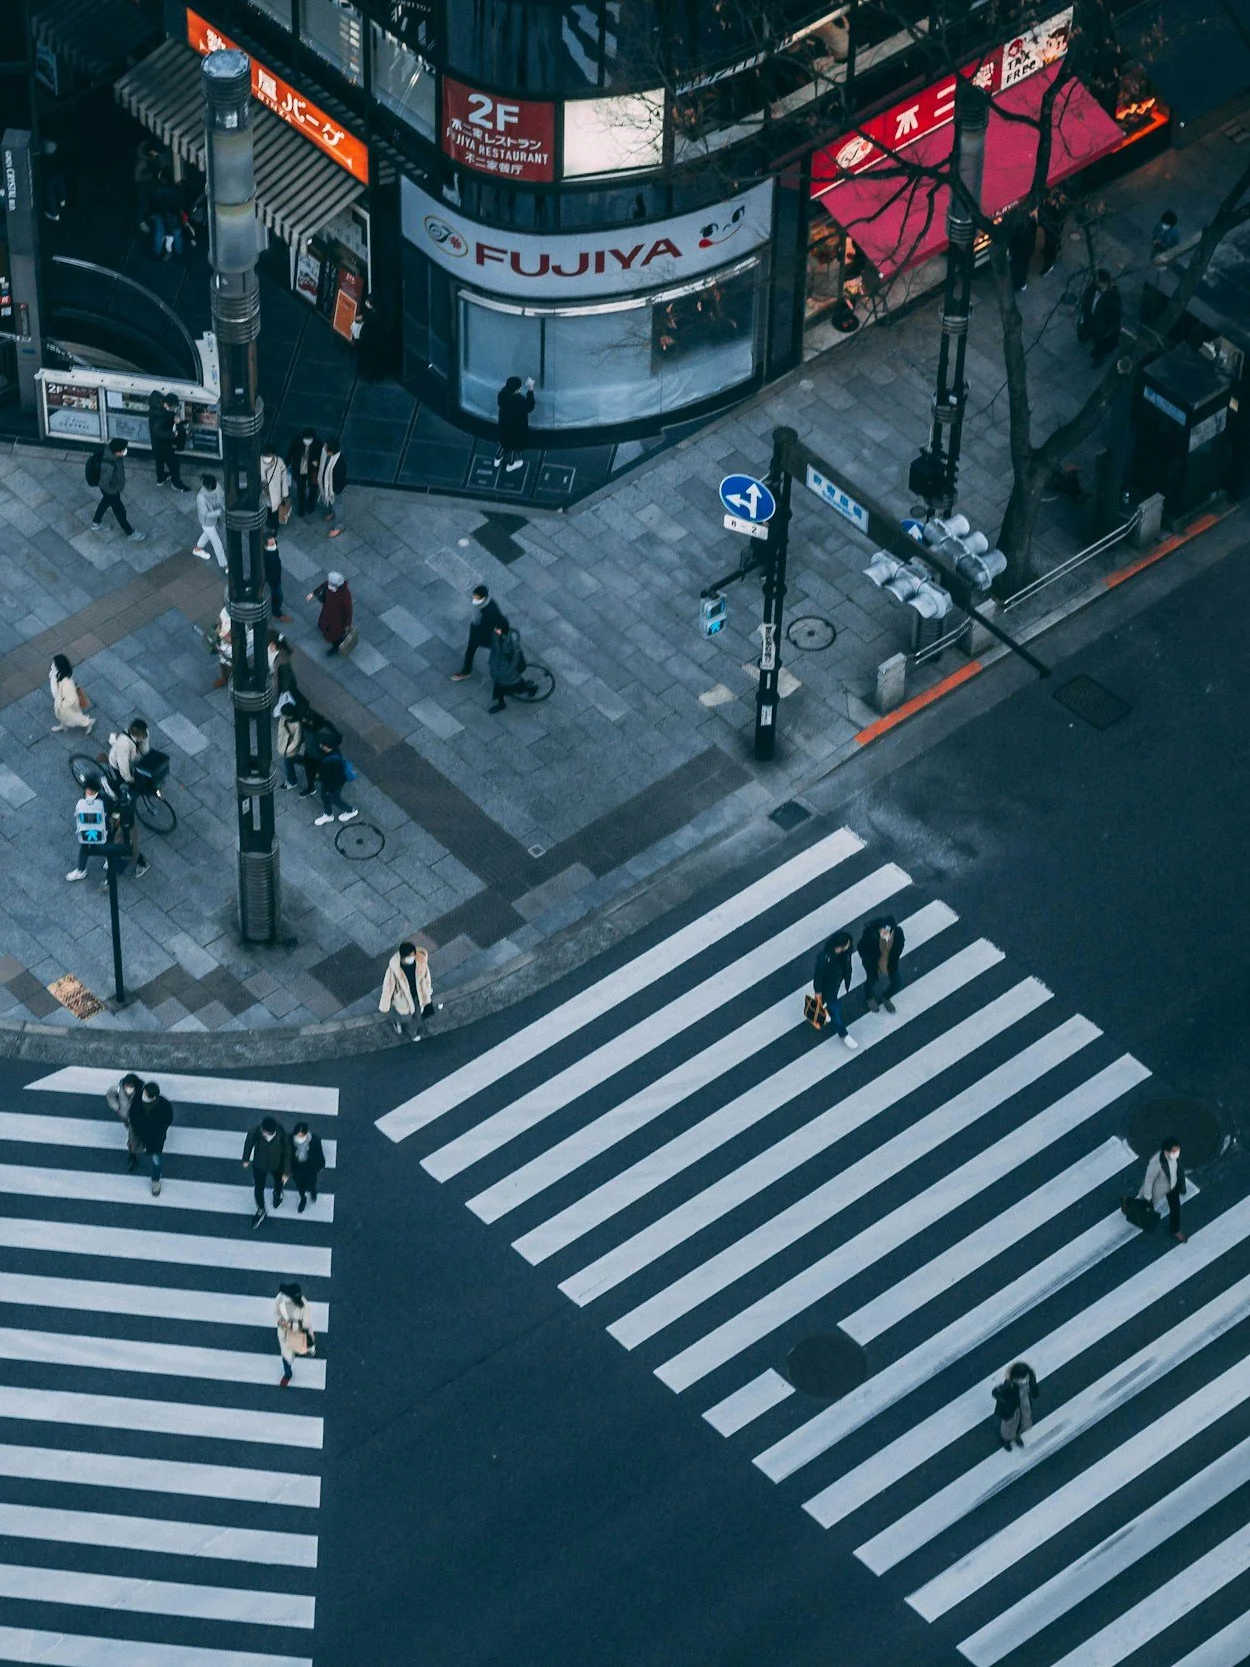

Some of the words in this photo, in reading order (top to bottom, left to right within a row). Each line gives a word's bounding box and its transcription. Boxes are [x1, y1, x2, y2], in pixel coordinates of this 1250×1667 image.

[258, 92, 292, 124] GINZA
[468, 93, 520, 131] 2F
[446, 126, 476, 152] FUJIYA
[478, 144, 549, 166] RESTAURANT
[452, 117, 542, 151] 不二家レストラン
[474, 238, 683, 278] FUJIYA
